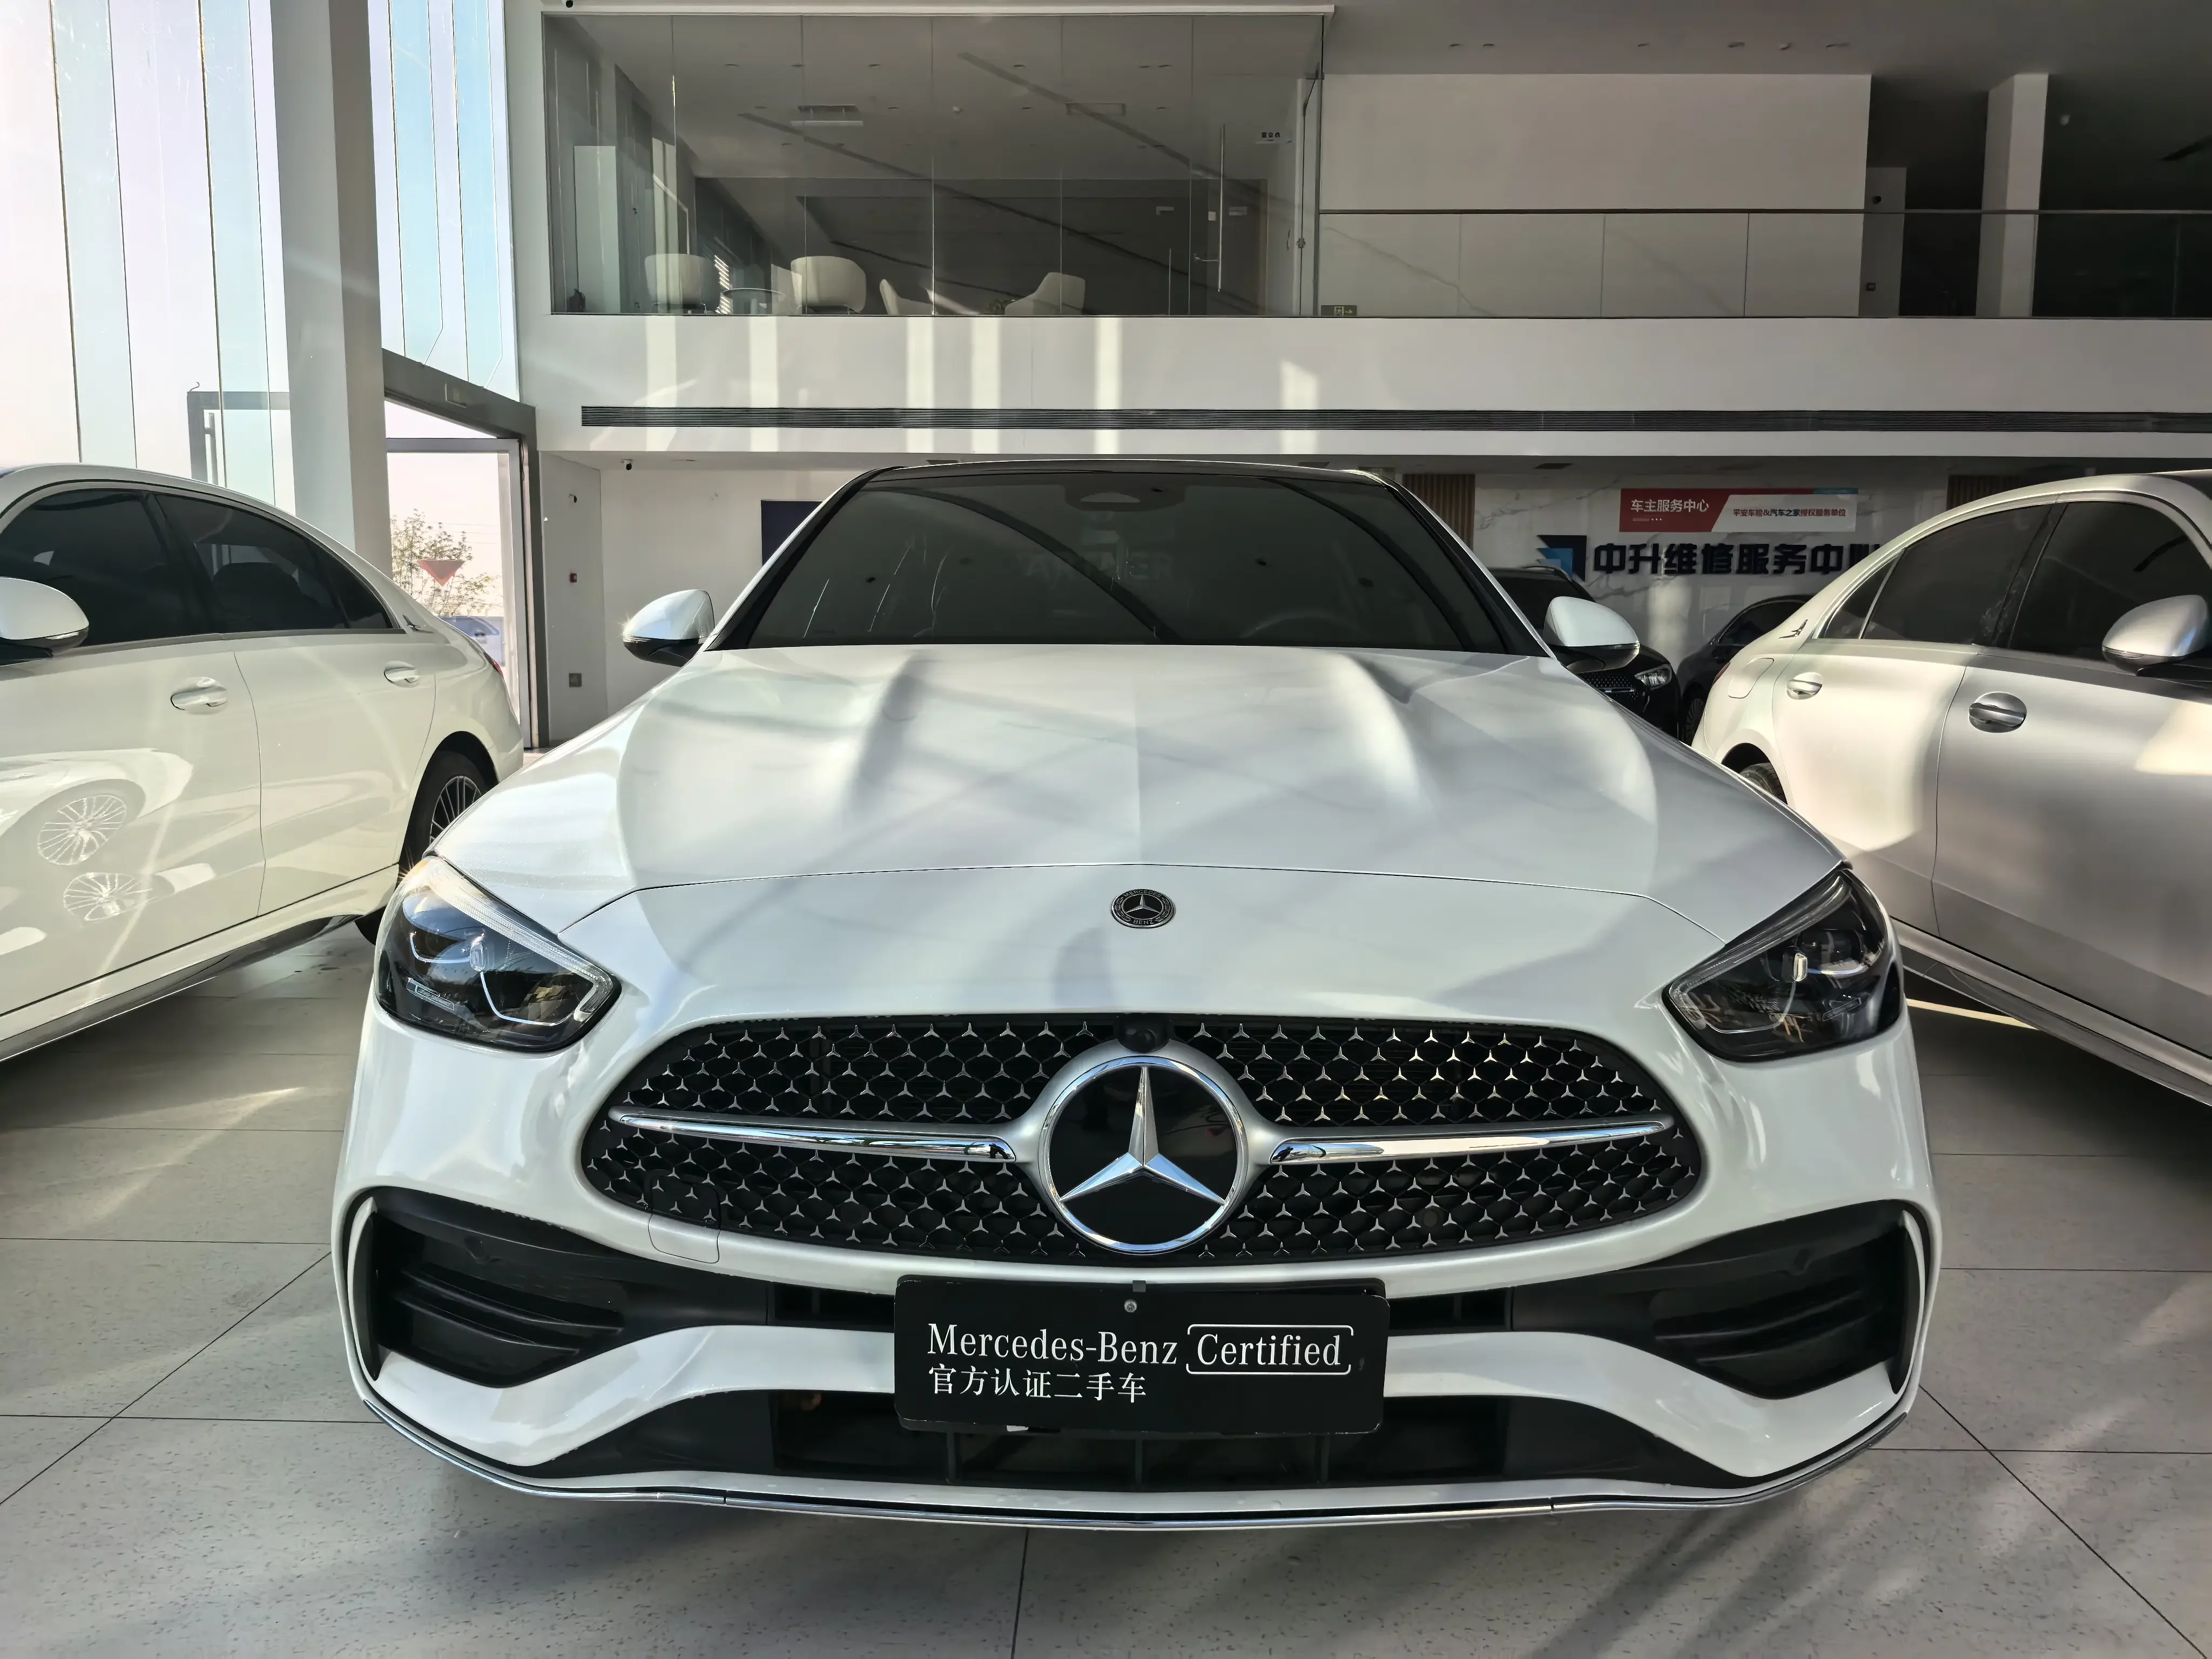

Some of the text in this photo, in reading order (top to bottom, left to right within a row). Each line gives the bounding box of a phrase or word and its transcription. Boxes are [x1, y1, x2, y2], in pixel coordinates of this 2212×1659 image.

[1630, 498, 1709, 513] 车主服务中心
[1123, 889, 1162, 898] MERCEDES
[927, 1323, 1341, 1366] Mercedes-Benz Certified
[928, 1364, 1146, 1403] 官方认证二手车
